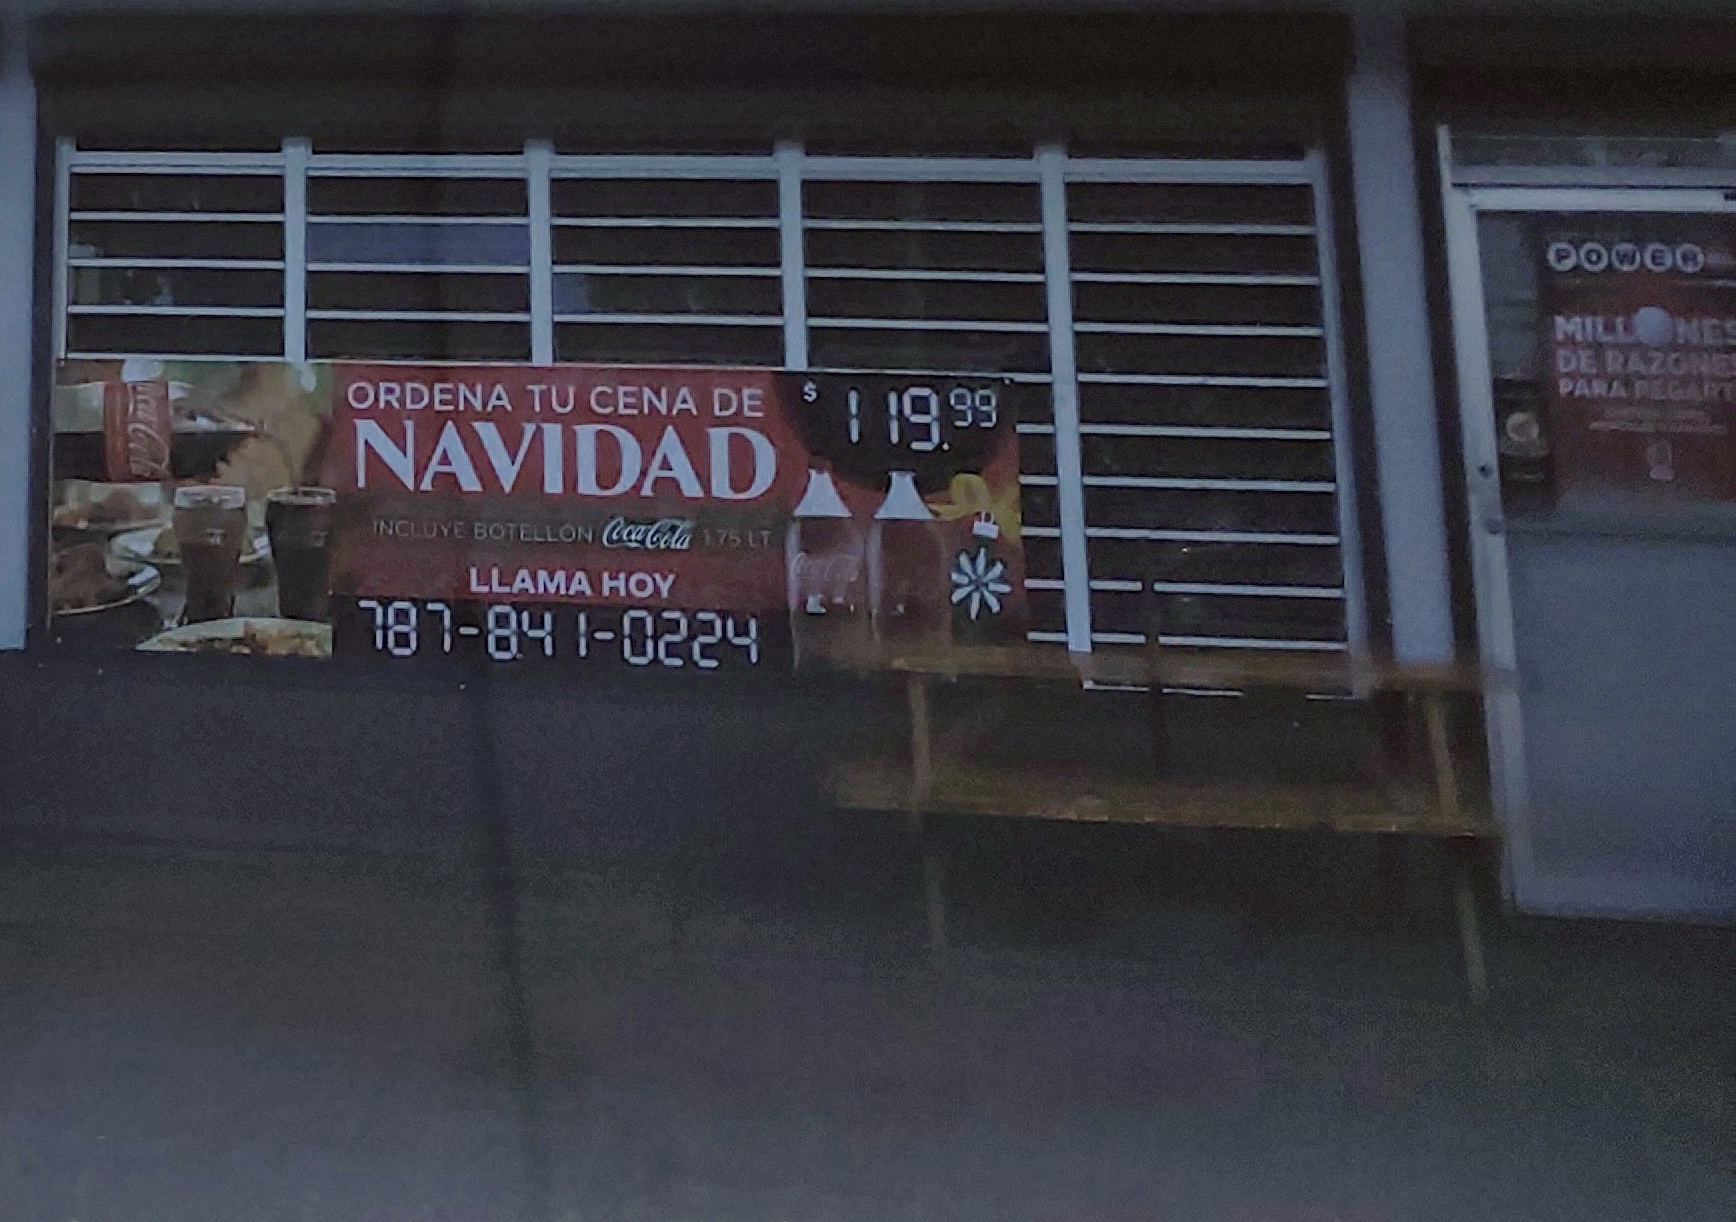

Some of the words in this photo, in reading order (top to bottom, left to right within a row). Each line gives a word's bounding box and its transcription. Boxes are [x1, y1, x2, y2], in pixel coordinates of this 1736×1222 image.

[1556, 348, 1597, 375] DE
[347, 382, 513, 413] ORDENA
[525, 384, 576, 414] TU
[589, 385, 698, 416] CENA
[714, 388, 764, 418] DE
[354, 418, 777, 499] NAVIDAD
[373, 518, 464, 539] INCLUYE
[749, 528, 772, 547] LT
[469, 566, 592, 596] LLAMA
[602, 571, 677, 598] HOY
[358, 599, 759, 669] 787-841-0224
